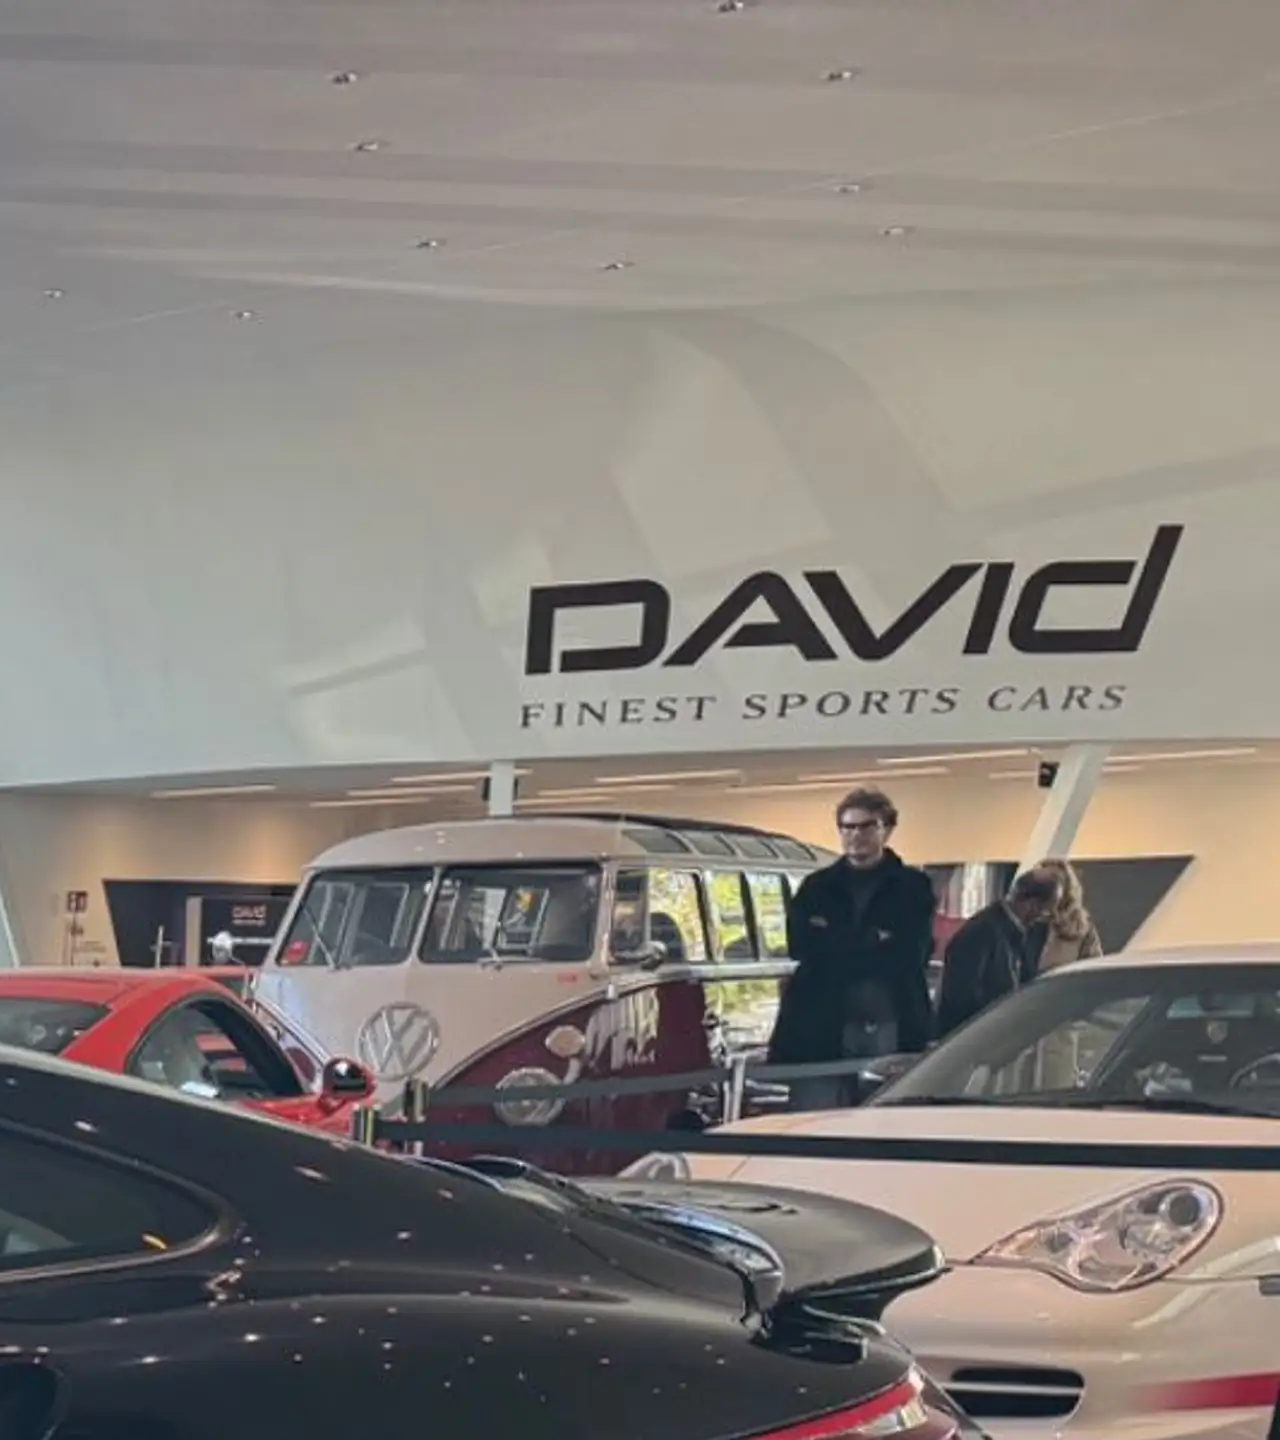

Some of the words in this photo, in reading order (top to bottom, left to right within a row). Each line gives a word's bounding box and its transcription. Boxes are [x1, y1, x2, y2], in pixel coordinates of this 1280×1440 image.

[520, 696, 716, 729] FINEST
[741, 688, 960, 720] SPORTS
[987, 685, 1127, 713] CARS
